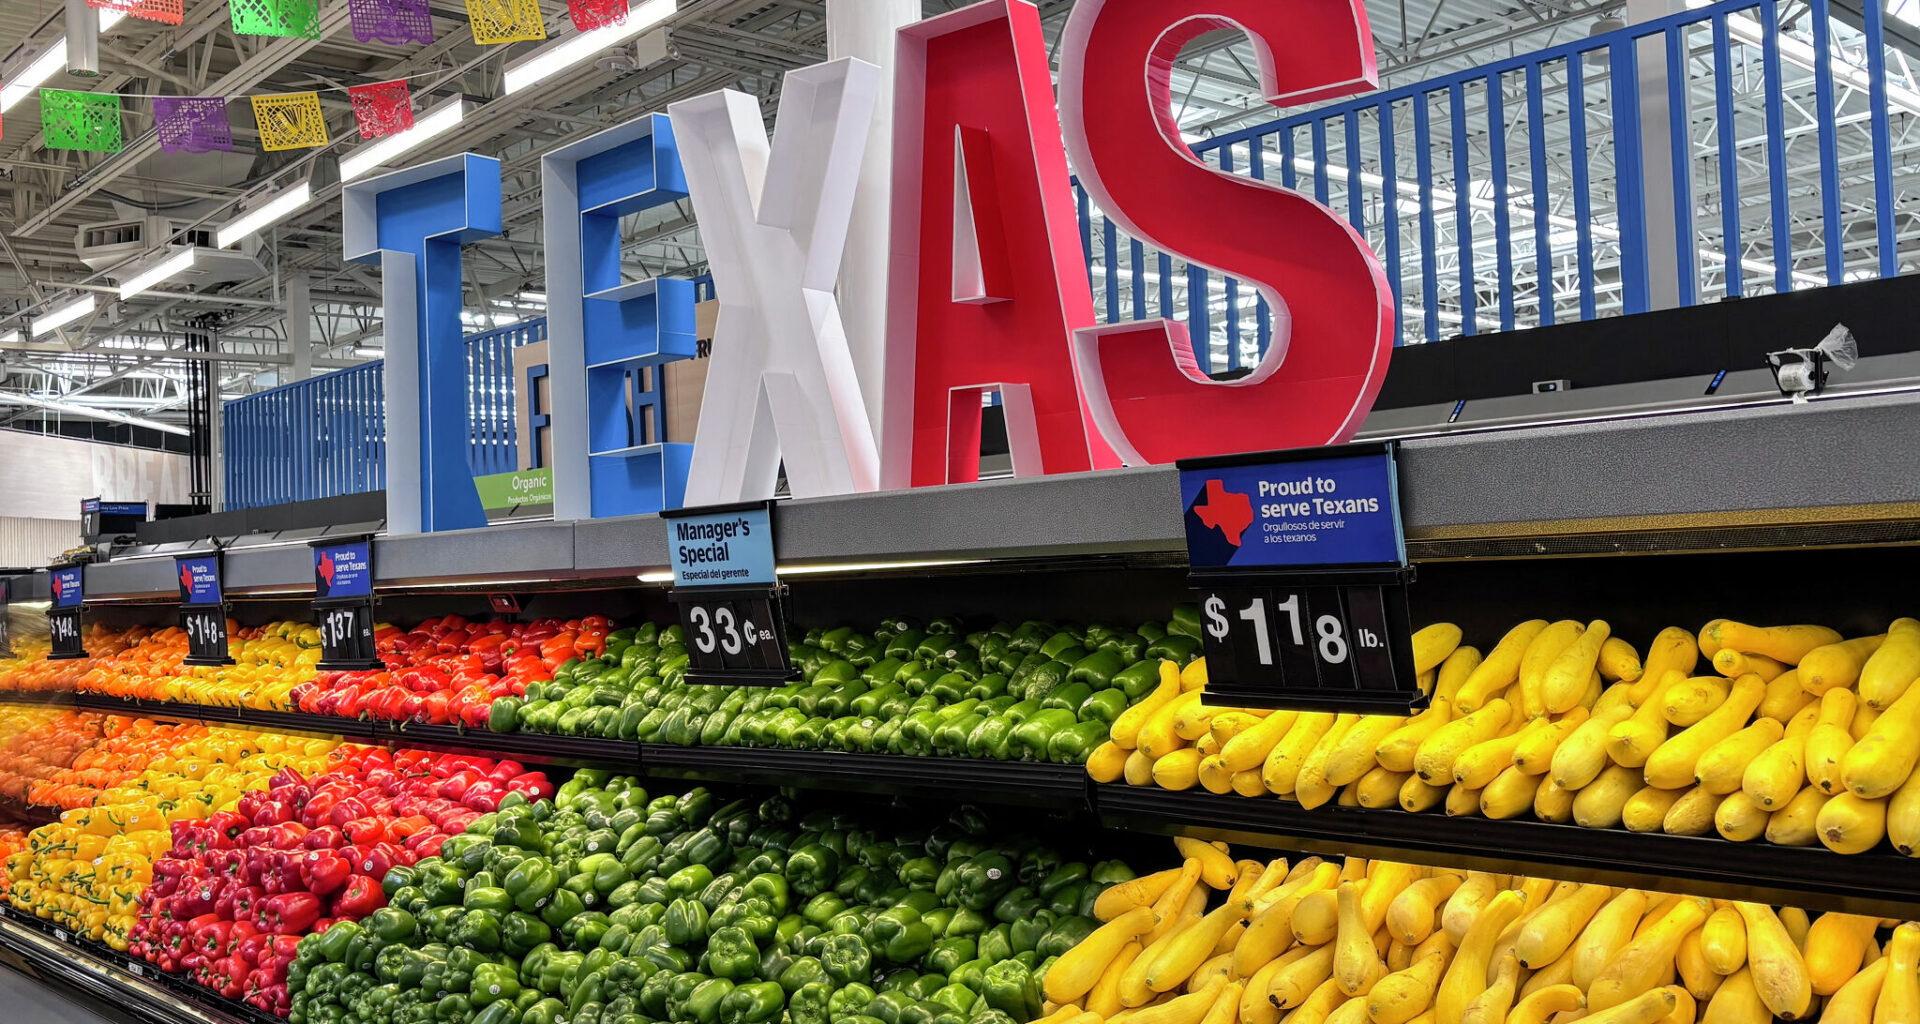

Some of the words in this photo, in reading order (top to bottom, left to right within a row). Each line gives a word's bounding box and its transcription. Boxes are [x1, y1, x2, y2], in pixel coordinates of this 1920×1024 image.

[343, 0, 1394, 534] TEXAS
[512, 474, 547, 493] Organic
[1258, 477, 1313, 497] Proud
[1316, 477, 1336, 493] to
[1261, 502, 1310, 518] serve
[1312, 497, 1379, 516] Texans
[677, 517, 750, 542] Manager's
[1263, 521, 1307, 533] Orgullosos
[1308, 521, 1320, 530] de
[1320, 519, 1345, 529] servir
[1270, 534, 1282, 543] los
[1283, 533, 1317, 542] texanos
[335, 552, 349, 561] Proud
[679, 542, 729, 566] Special
[349, 562, 366, 571] Texans
[682, 570, 709, 581] Especial
[710, 569, 721, 579] del
[722, 568, 750, 580] gerente
[759, 629, 774, 640] ea.
[1358, 628, 1384, 648] lb.
